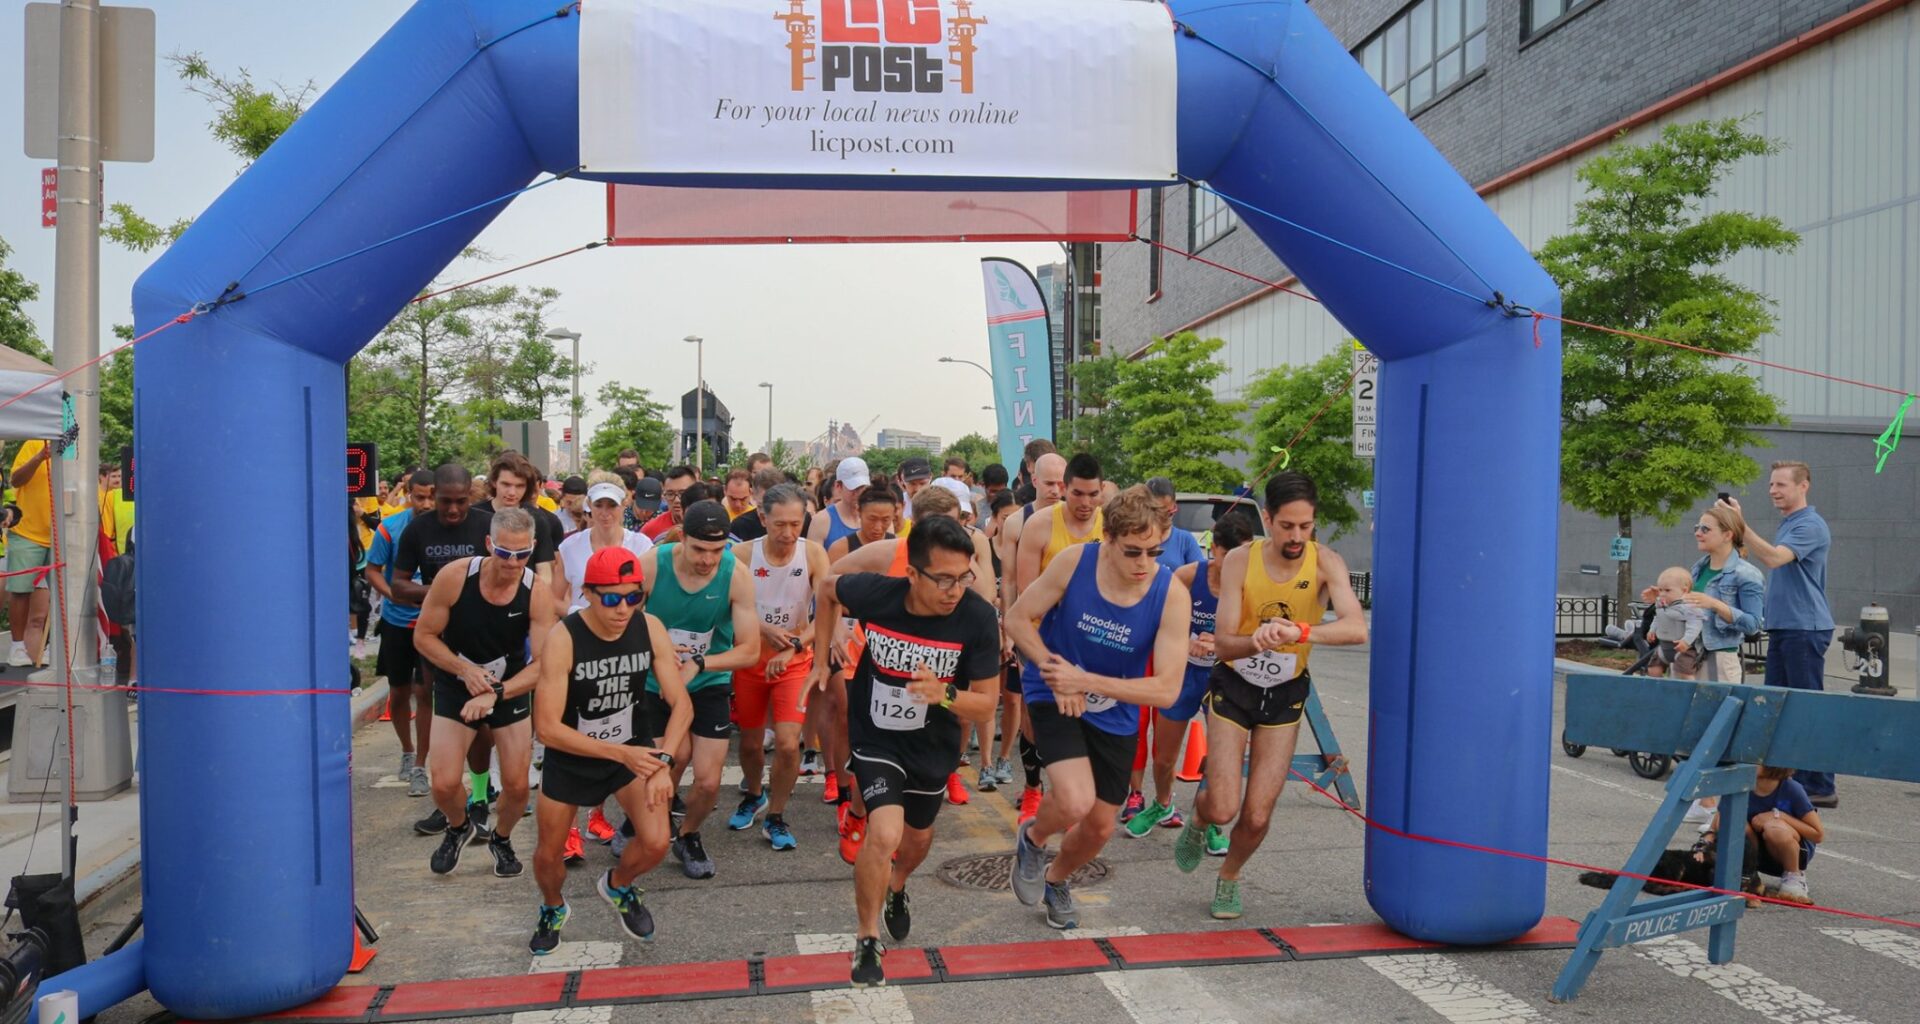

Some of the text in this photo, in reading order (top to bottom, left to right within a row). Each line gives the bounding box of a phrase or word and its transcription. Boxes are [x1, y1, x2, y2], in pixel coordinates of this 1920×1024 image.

[714, 98, 1019, 128] For your local news online
[810, 130, 954, 160] licpost.com
[45, 175, 56, 185] NO
[1358, 443, 1376, 451] HIG
[764, 613, 789, 625] 828
[1082, 612, 1132, 635] woodside
[865, 628, 962, 658] UNDOCUMENTED
[1077, 621, 1129, 644] sunnyside
[679, 643, 707, 655] 68
[575, 651, 650, 680] SUSTAIN
[1247, 656, 1281, 675] 310
[597, 675, 630, 696] THE
[588, 692, 634, 712] PAIN
[874, 700, 917, 719] 1126
[1624, 901, 1729, 941] POLICE DEPT.
